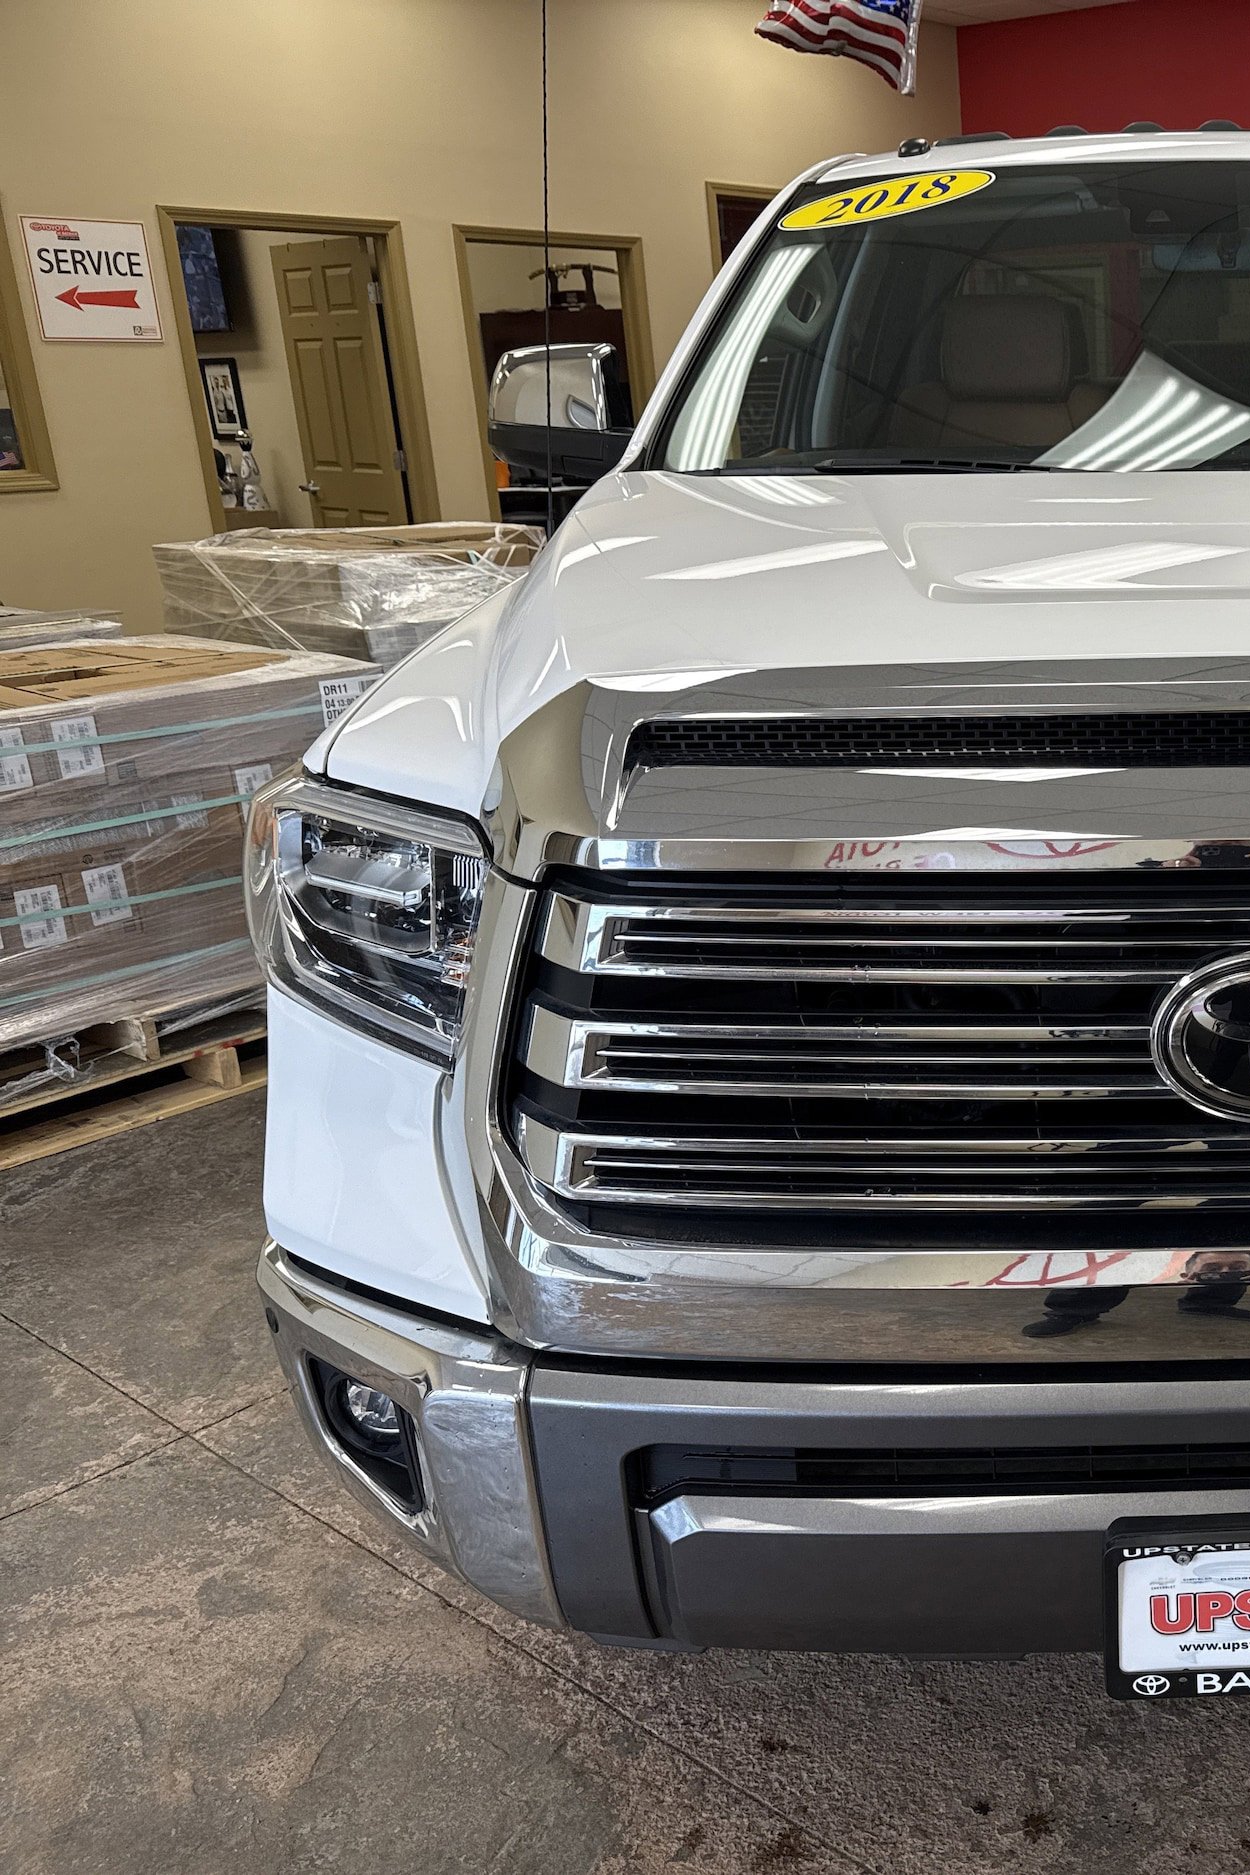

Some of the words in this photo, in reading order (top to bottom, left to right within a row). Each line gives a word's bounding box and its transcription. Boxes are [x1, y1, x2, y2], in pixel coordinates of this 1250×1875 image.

[816, 175, 957, 223] 2018
[37, 248, 143, 276] SERVICE
[323, 683, 347, 695] DR11
[325, 699, 336, 709] 04
[1123, 1542, 1250, 1558] UPSTATE
